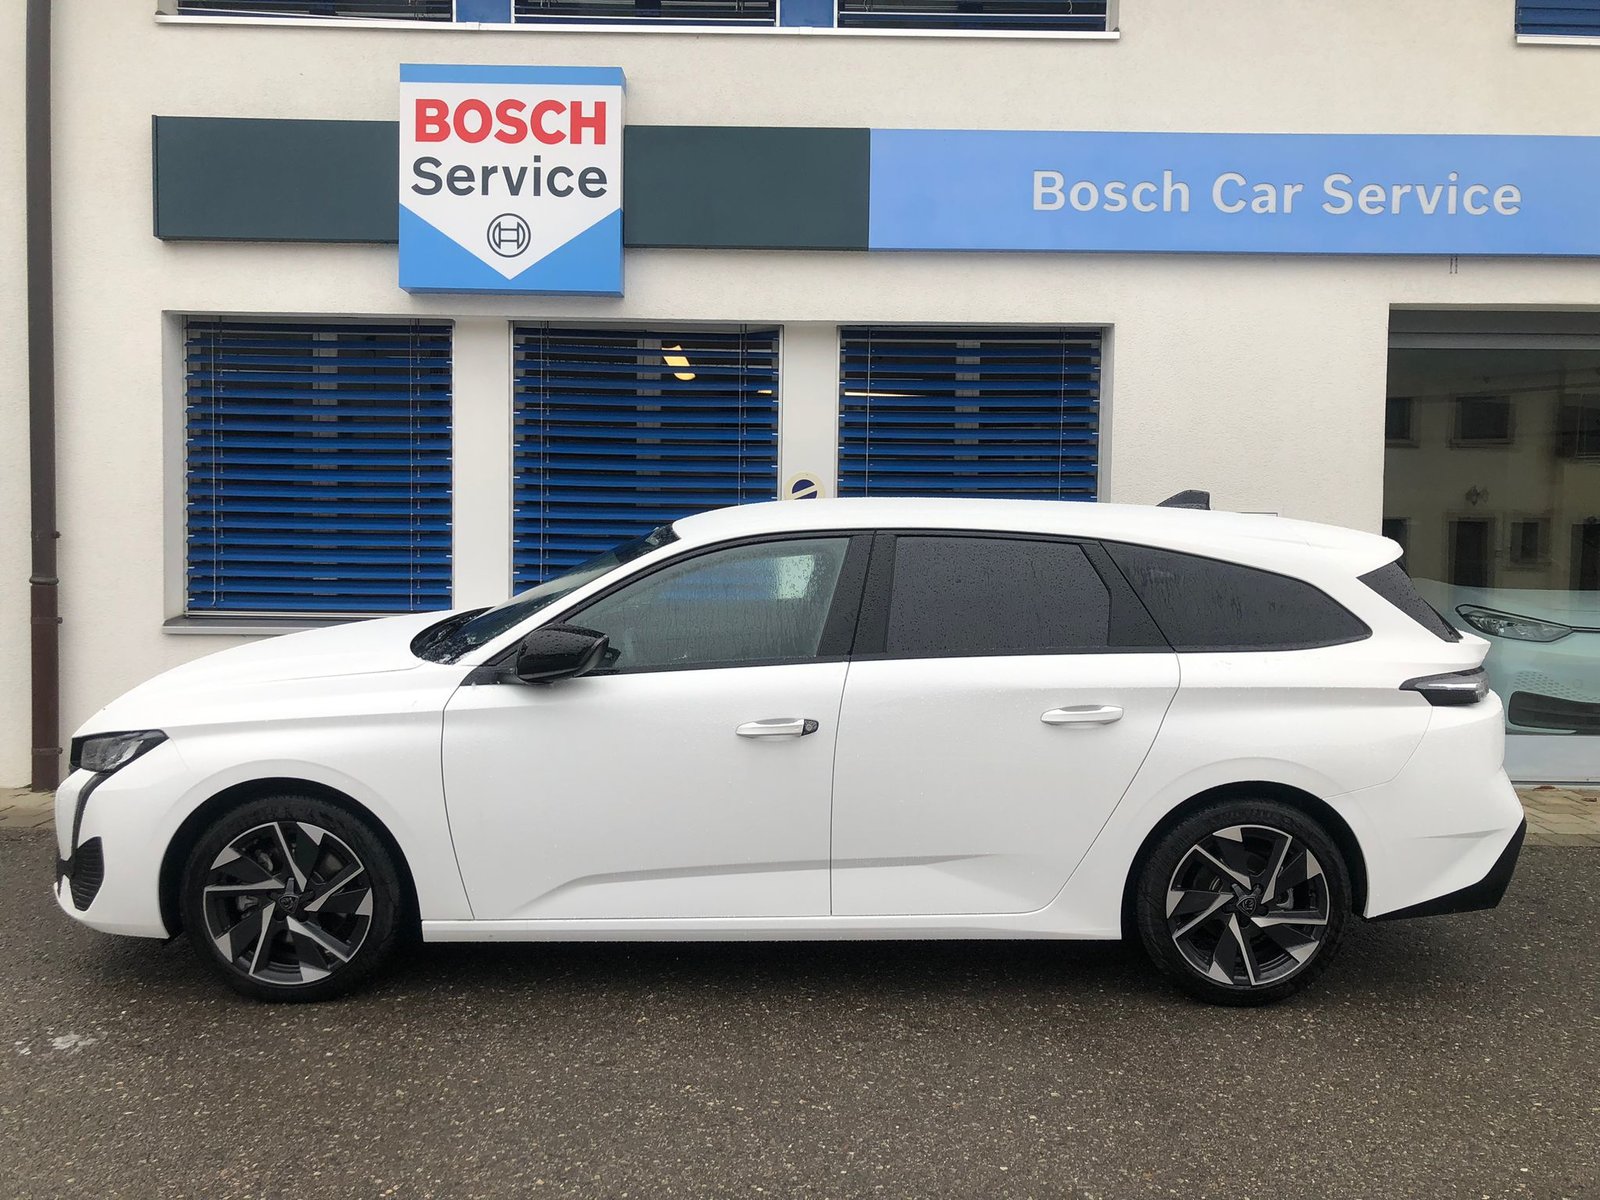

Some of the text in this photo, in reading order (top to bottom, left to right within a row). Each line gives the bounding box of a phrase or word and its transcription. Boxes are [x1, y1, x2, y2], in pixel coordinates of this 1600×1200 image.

[415, 98, 607, 145] BOSCH
[411, 155, 608, 198] Service
[1033, 170, 1522, 216] Bosch Car Service
